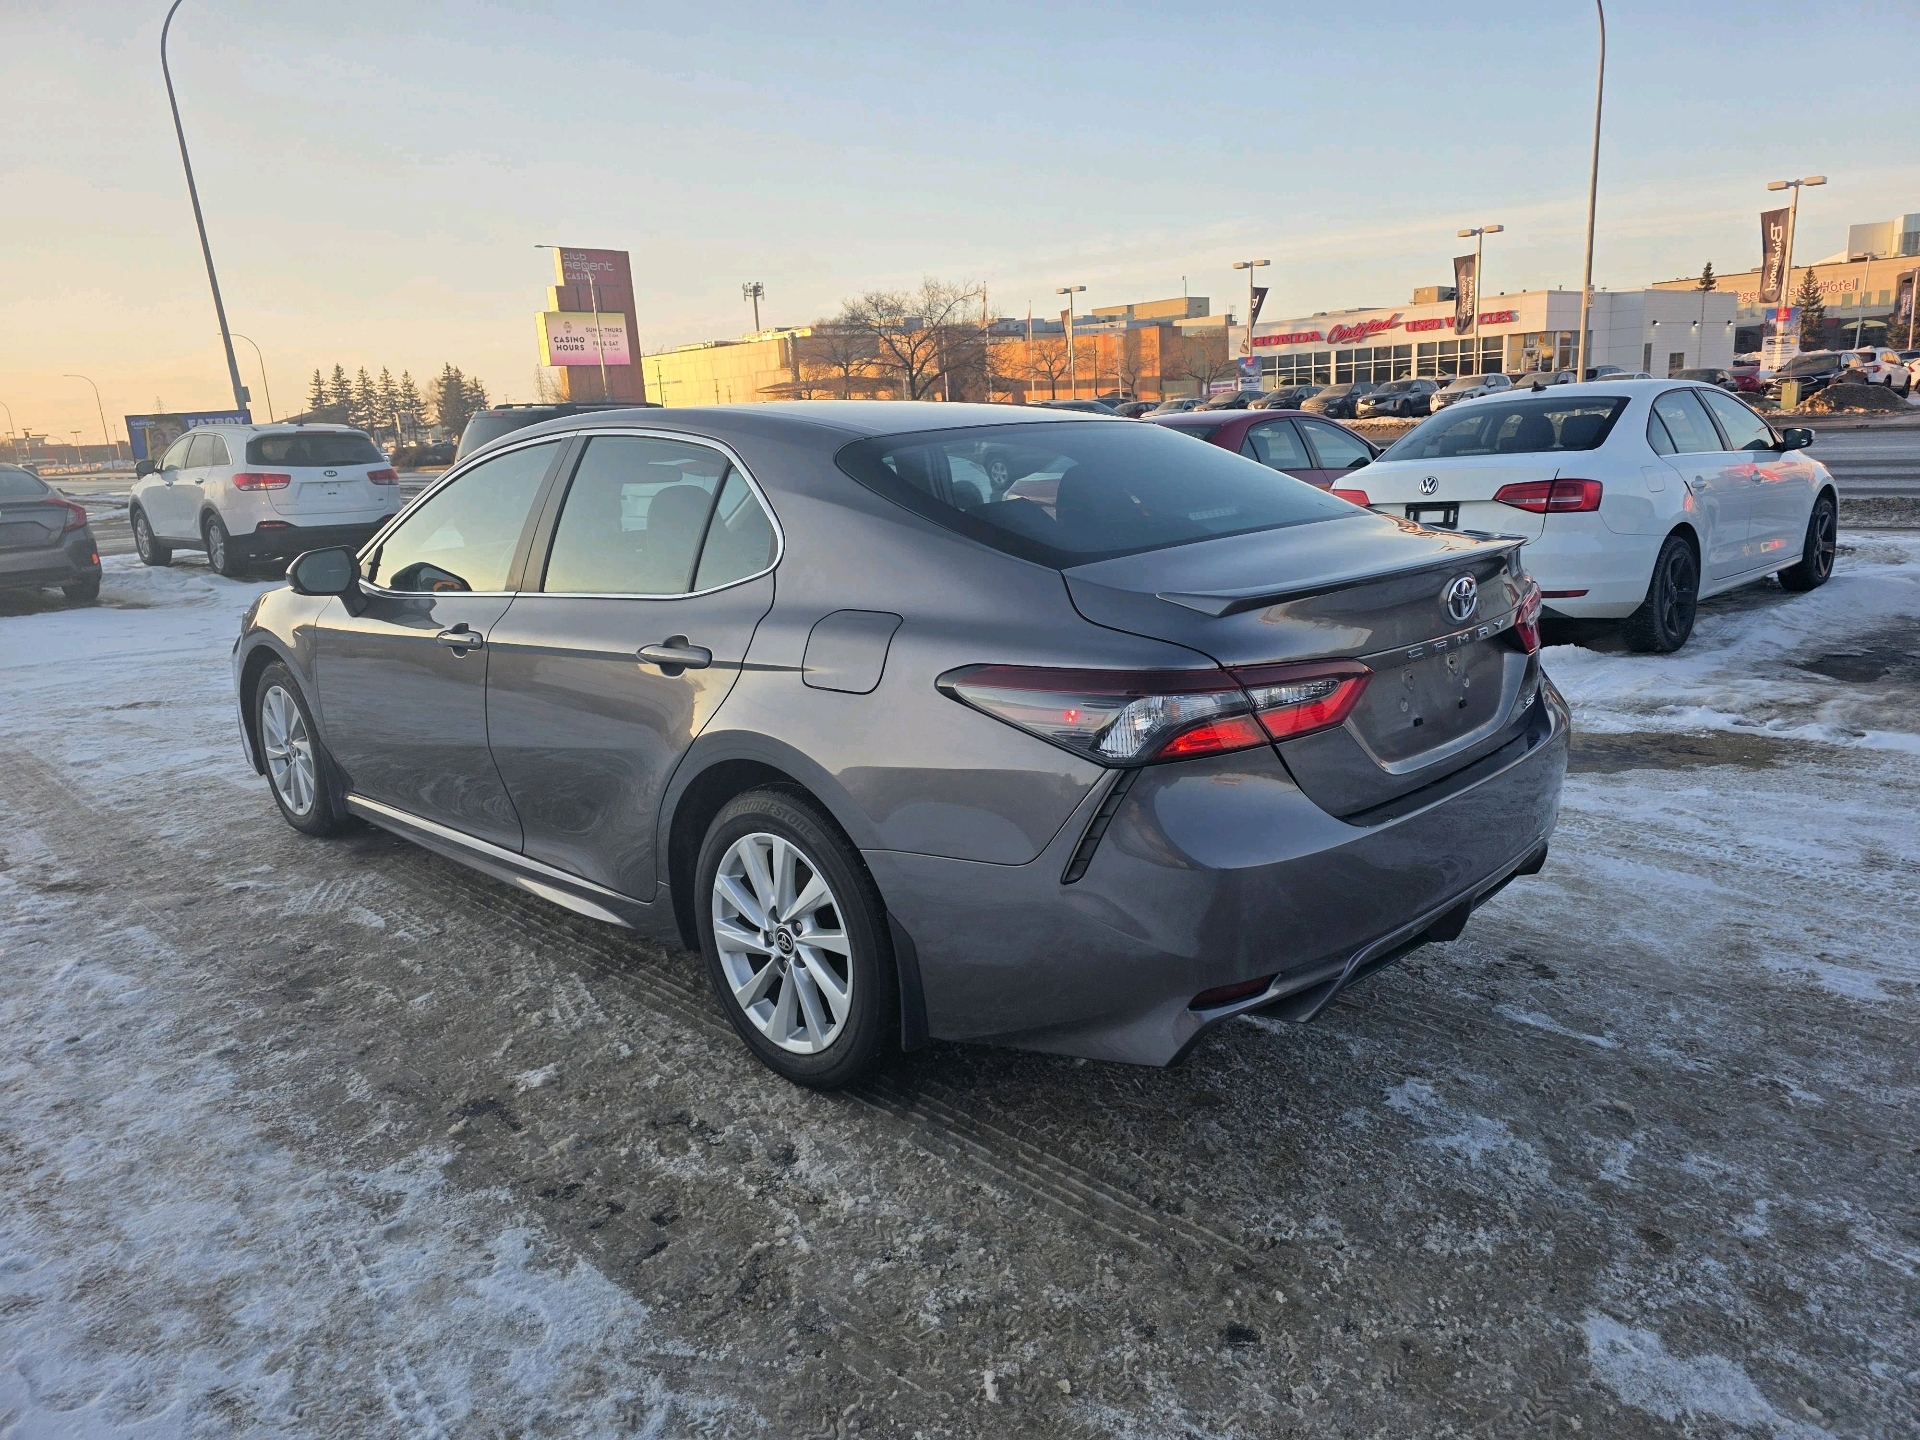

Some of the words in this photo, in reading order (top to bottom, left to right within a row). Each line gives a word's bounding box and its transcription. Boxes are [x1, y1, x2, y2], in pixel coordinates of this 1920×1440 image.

[562, 252, 586, 261] club
[563, 261, 614, 271] Regent
[565, 272, 596, 280] CASINO
[1820, 279, 1855, 292] Hotel
[1252, 331, 1323, 348] HONDA
[1327, 313, 1402, 344] Certified
[1405, 319, 1441, 332] USED
[1445, 310, 1512, 328] VCLES
[733, 800, 814, 838] BRIDGESTONE
